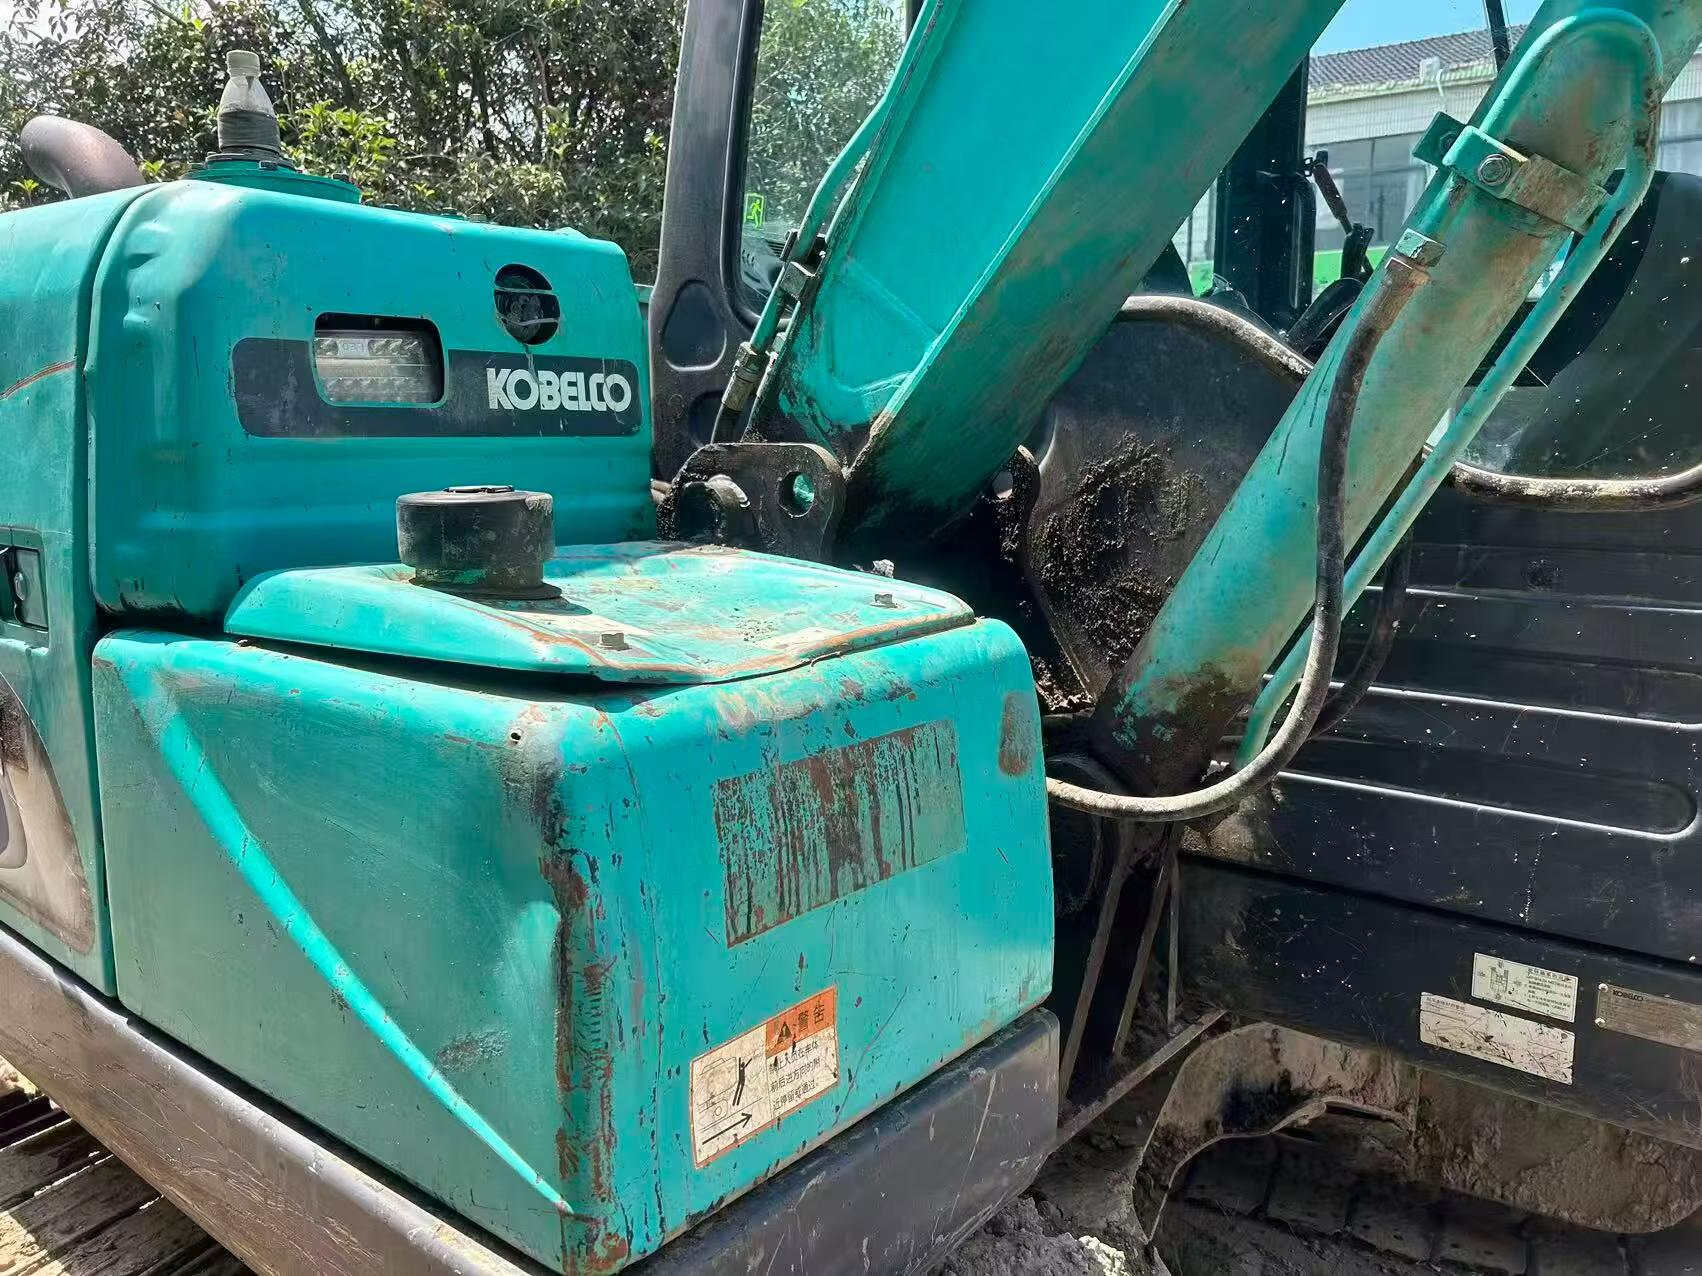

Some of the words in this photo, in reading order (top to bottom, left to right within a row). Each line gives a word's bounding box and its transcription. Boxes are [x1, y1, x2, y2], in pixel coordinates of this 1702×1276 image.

[486, 368, 632, 412] KOBELCO
[1612, 989, 1644, 1002] KOBELCO
[798, 1000, 825, 1032] 警告
